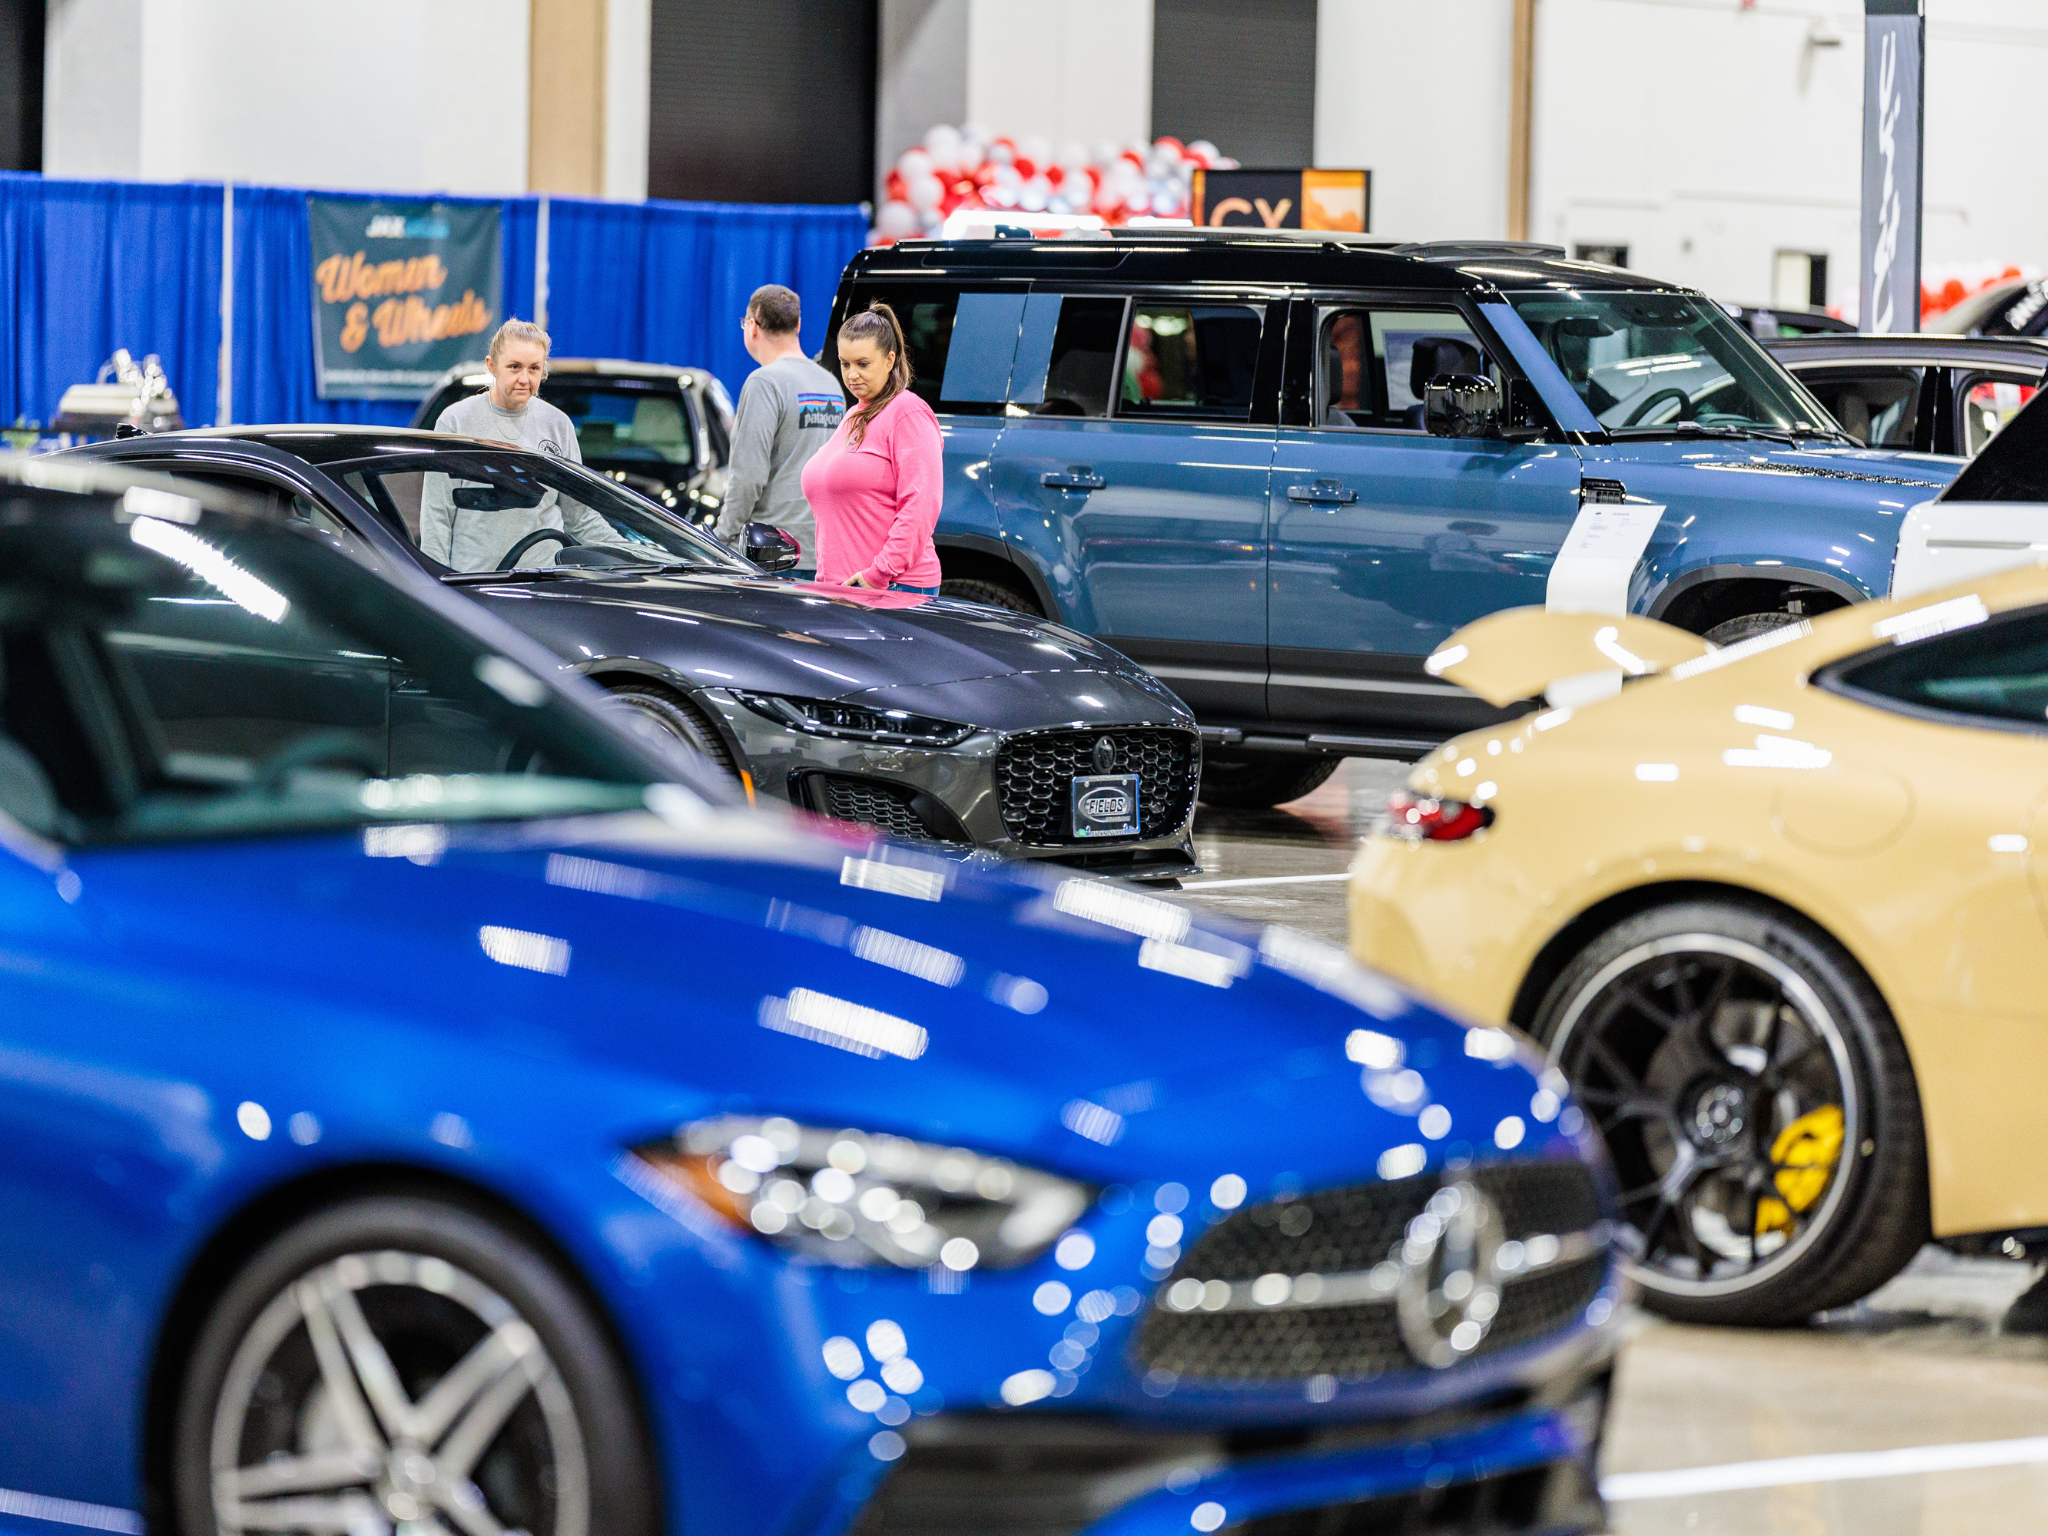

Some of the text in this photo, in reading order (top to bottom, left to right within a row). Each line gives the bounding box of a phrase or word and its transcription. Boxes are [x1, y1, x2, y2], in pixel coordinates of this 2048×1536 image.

[315, 249, 449, 304] Women
[339, 288, 493, 354] & Wheels
[804, 411, 843, 428] patagoni
[1087, 798, 1125, 814] FIELDS
